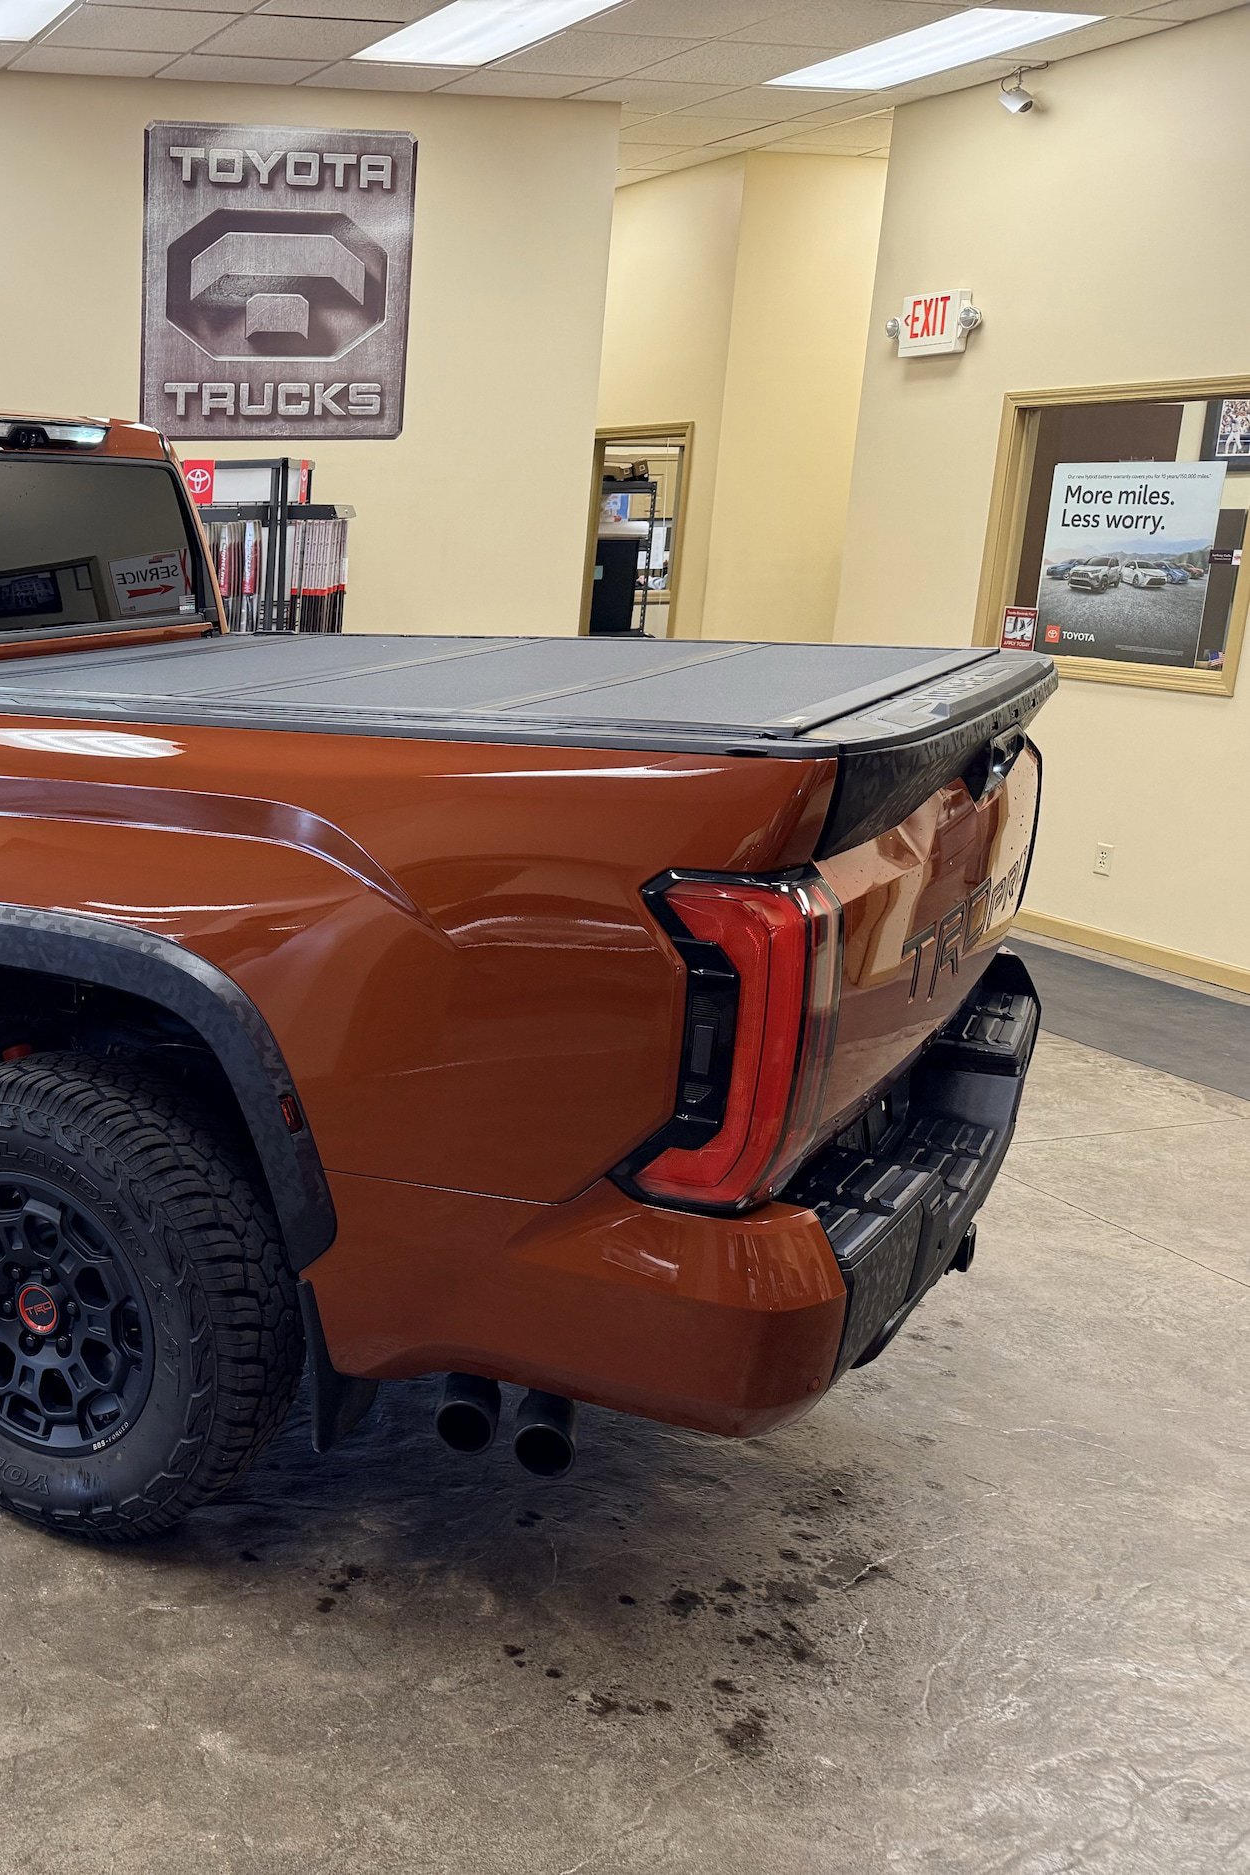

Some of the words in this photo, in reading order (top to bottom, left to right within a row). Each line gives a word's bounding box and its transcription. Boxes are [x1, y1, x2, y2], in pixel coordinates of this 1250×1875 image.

[169, 146, 393, 189] TOYOTA
[910, 295, 951, 339] EXIT
[164, 382, 382, 416] TRUCKS
[1064, 485, 1113, 505] More
[1117, 484, 1175, 506] miles.
[1061, 508, 1101, 528] Less
[1106, 514, 1165, 536] worry.
[1062, 630, 1095, 642] TOYOTA
[24, 1300, 52, 1317] TRD
